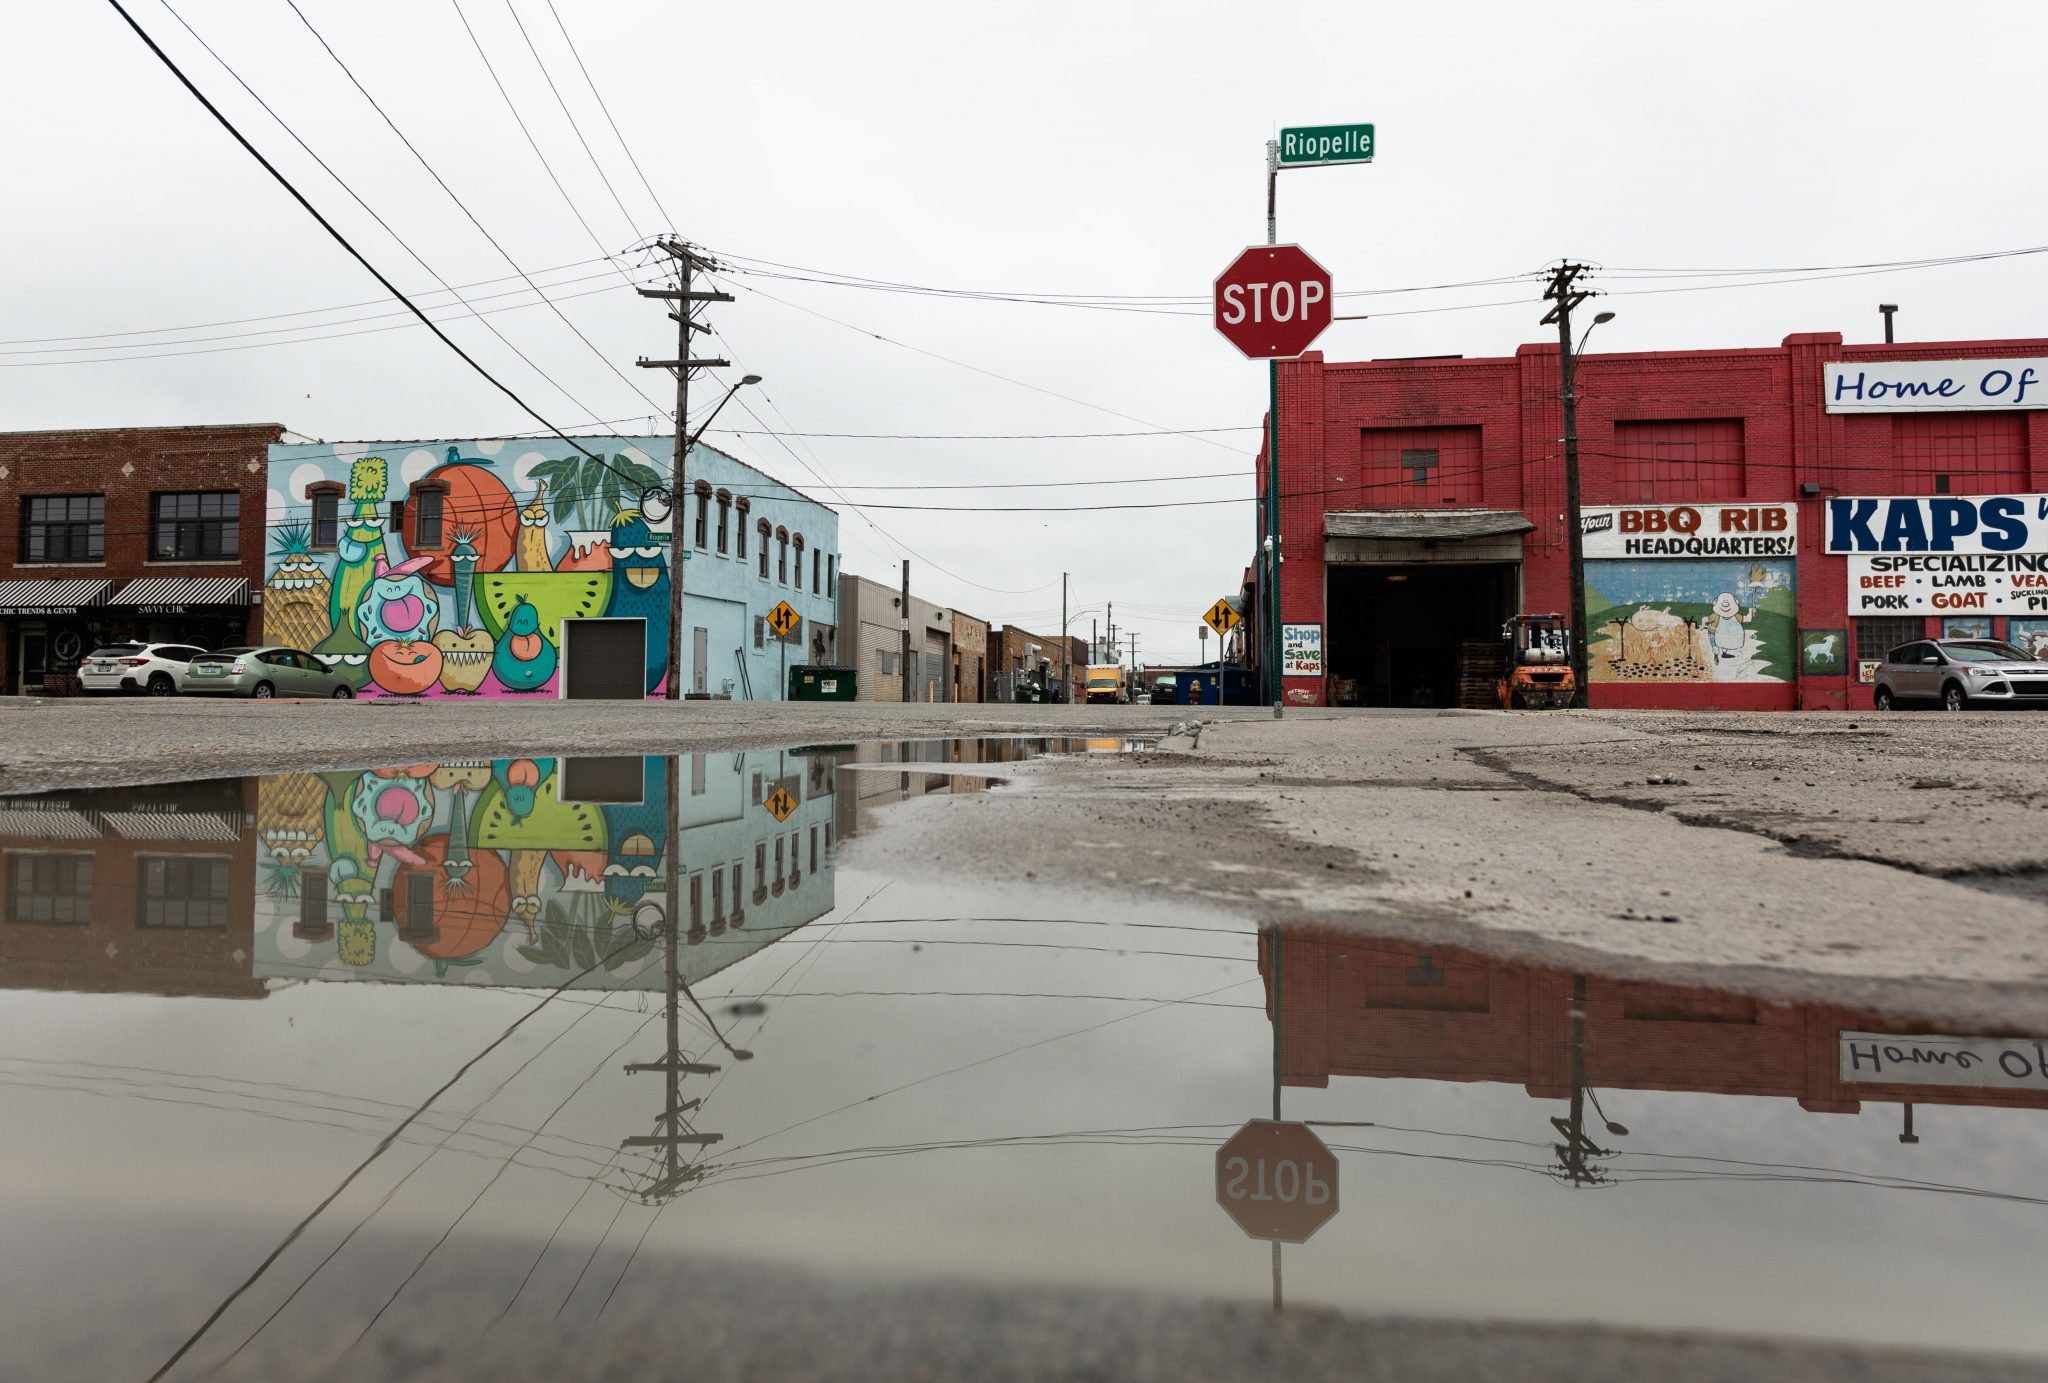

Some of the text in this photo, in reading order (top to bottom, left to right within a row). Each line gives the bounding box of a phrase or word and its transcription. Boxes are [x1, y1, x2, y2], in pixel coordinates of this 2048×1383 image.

[1285, 130, 1371, 158] Riopelle
[1222, 280, 1324, 325] STOP
[1835, 368, 2039, 404] Home Of
[1619, 507, 1702, 537] BBQ
[1720, 507, 1788, 533] RIB
[1830, 498, 2028, 552] KAPS
[1625, 536, 1796, 556] HEADQUARTERS!
[1860, 574, 2048, 589] BEEF LAMB VEA
[0, 607, 16, 615] CHIC
[17, 607, 46, 615] TRENDS
[46, 607, 52, 615] &
[138, 605, 188, 614] SAVVY CHIC
[1861, 592, 2048, 611] PORK GOAT PI
[1284, 627, 1320, 644] Shop
[1284, 649, 1320, 660] Save
[1285, 661, 1320, 672] at Kaps
